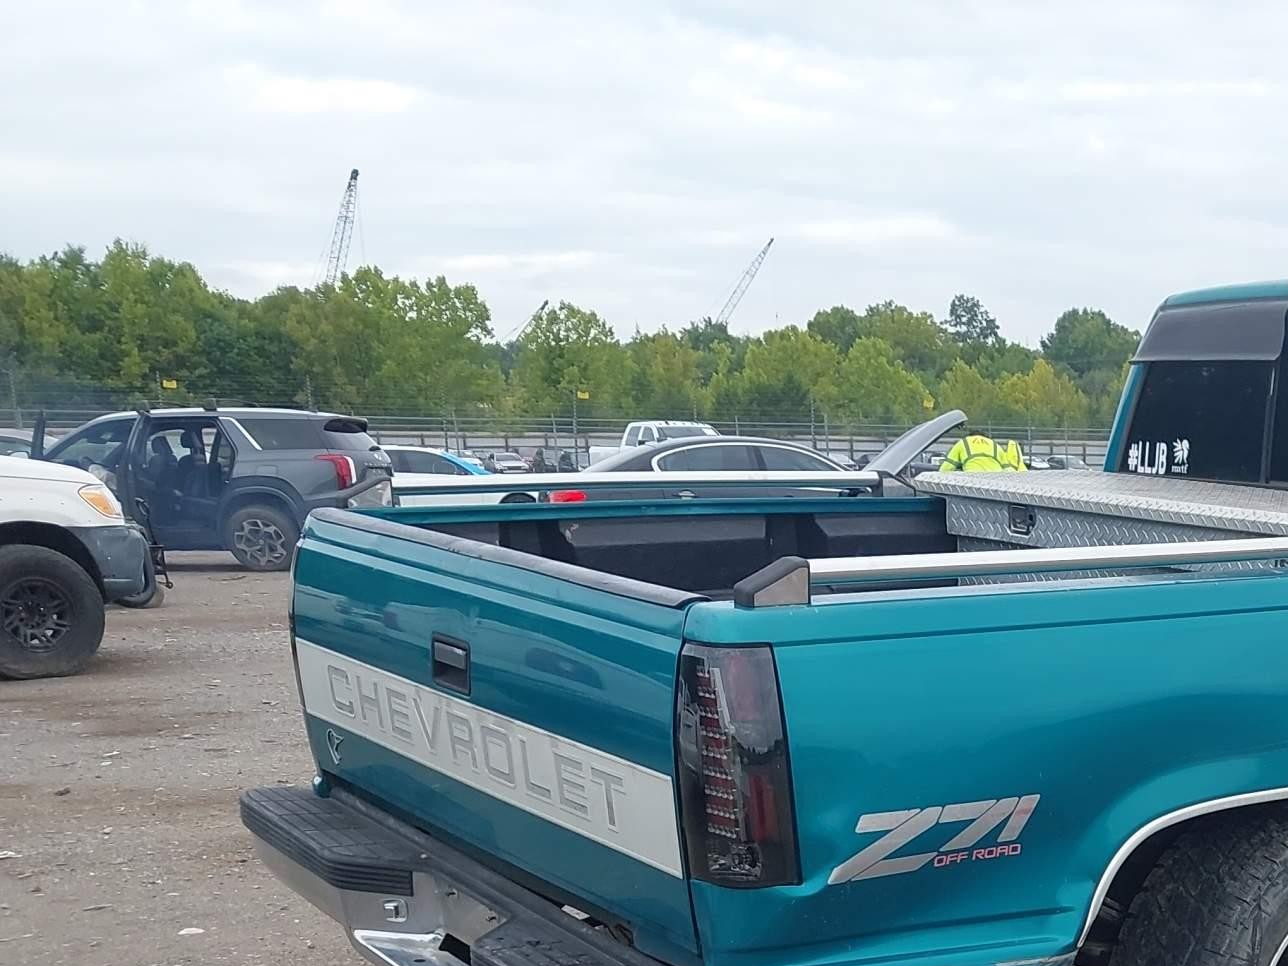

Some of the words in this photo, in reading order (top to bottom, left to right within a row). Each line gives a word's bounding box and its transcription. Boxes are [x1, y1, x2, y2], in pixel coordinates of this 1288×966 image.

[1128, 441, 1167, 475] #LLJB
[327, 664, 627, 834] CHEVROLET
[828, 794, 1041, 885] Z71
[933, 851, 969, 868] OFF
[972, 843, 1022, 861] ROAD
